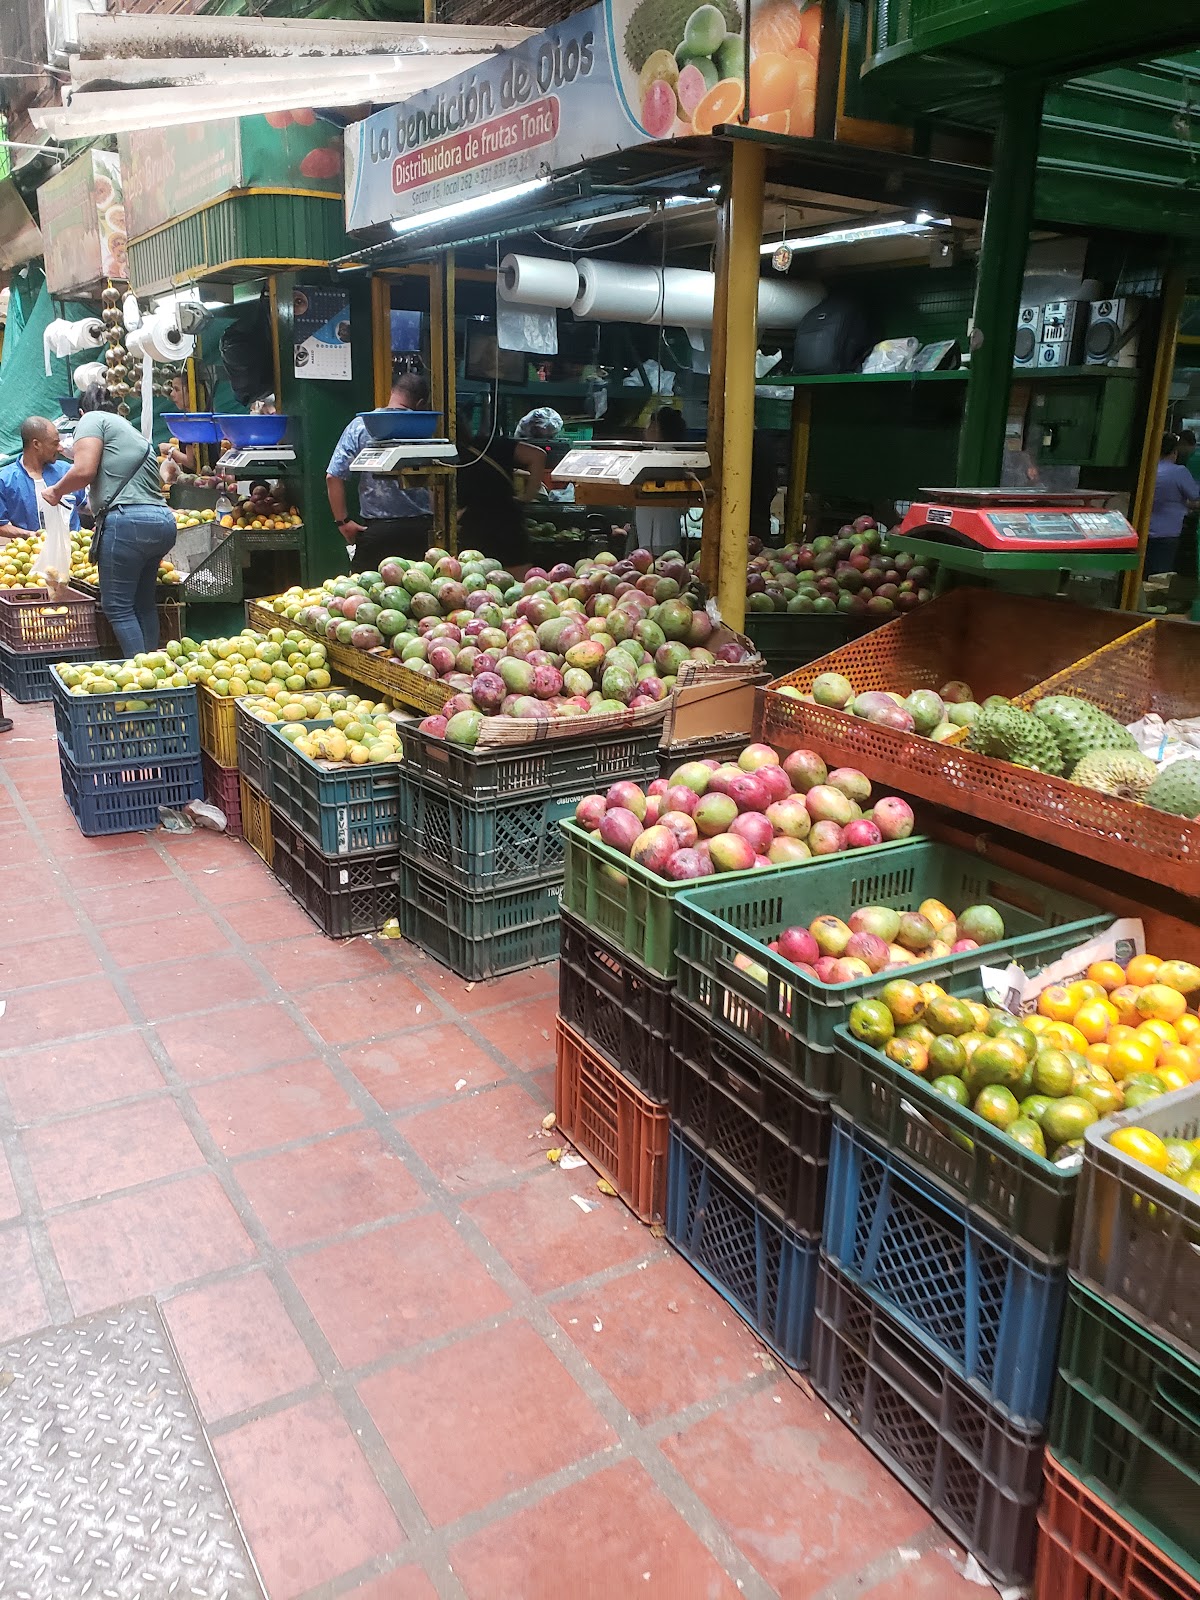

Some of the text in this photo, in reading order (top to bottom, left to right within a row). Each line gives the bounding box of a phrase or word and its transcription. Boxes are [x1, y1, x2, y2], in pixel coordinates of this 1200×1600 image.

[370, 31, 595, 164] La bendición de Dios
[395, 108, 553, 186] Distribuidora de frutas Toño
[412, 189, 432, 206] Sector
